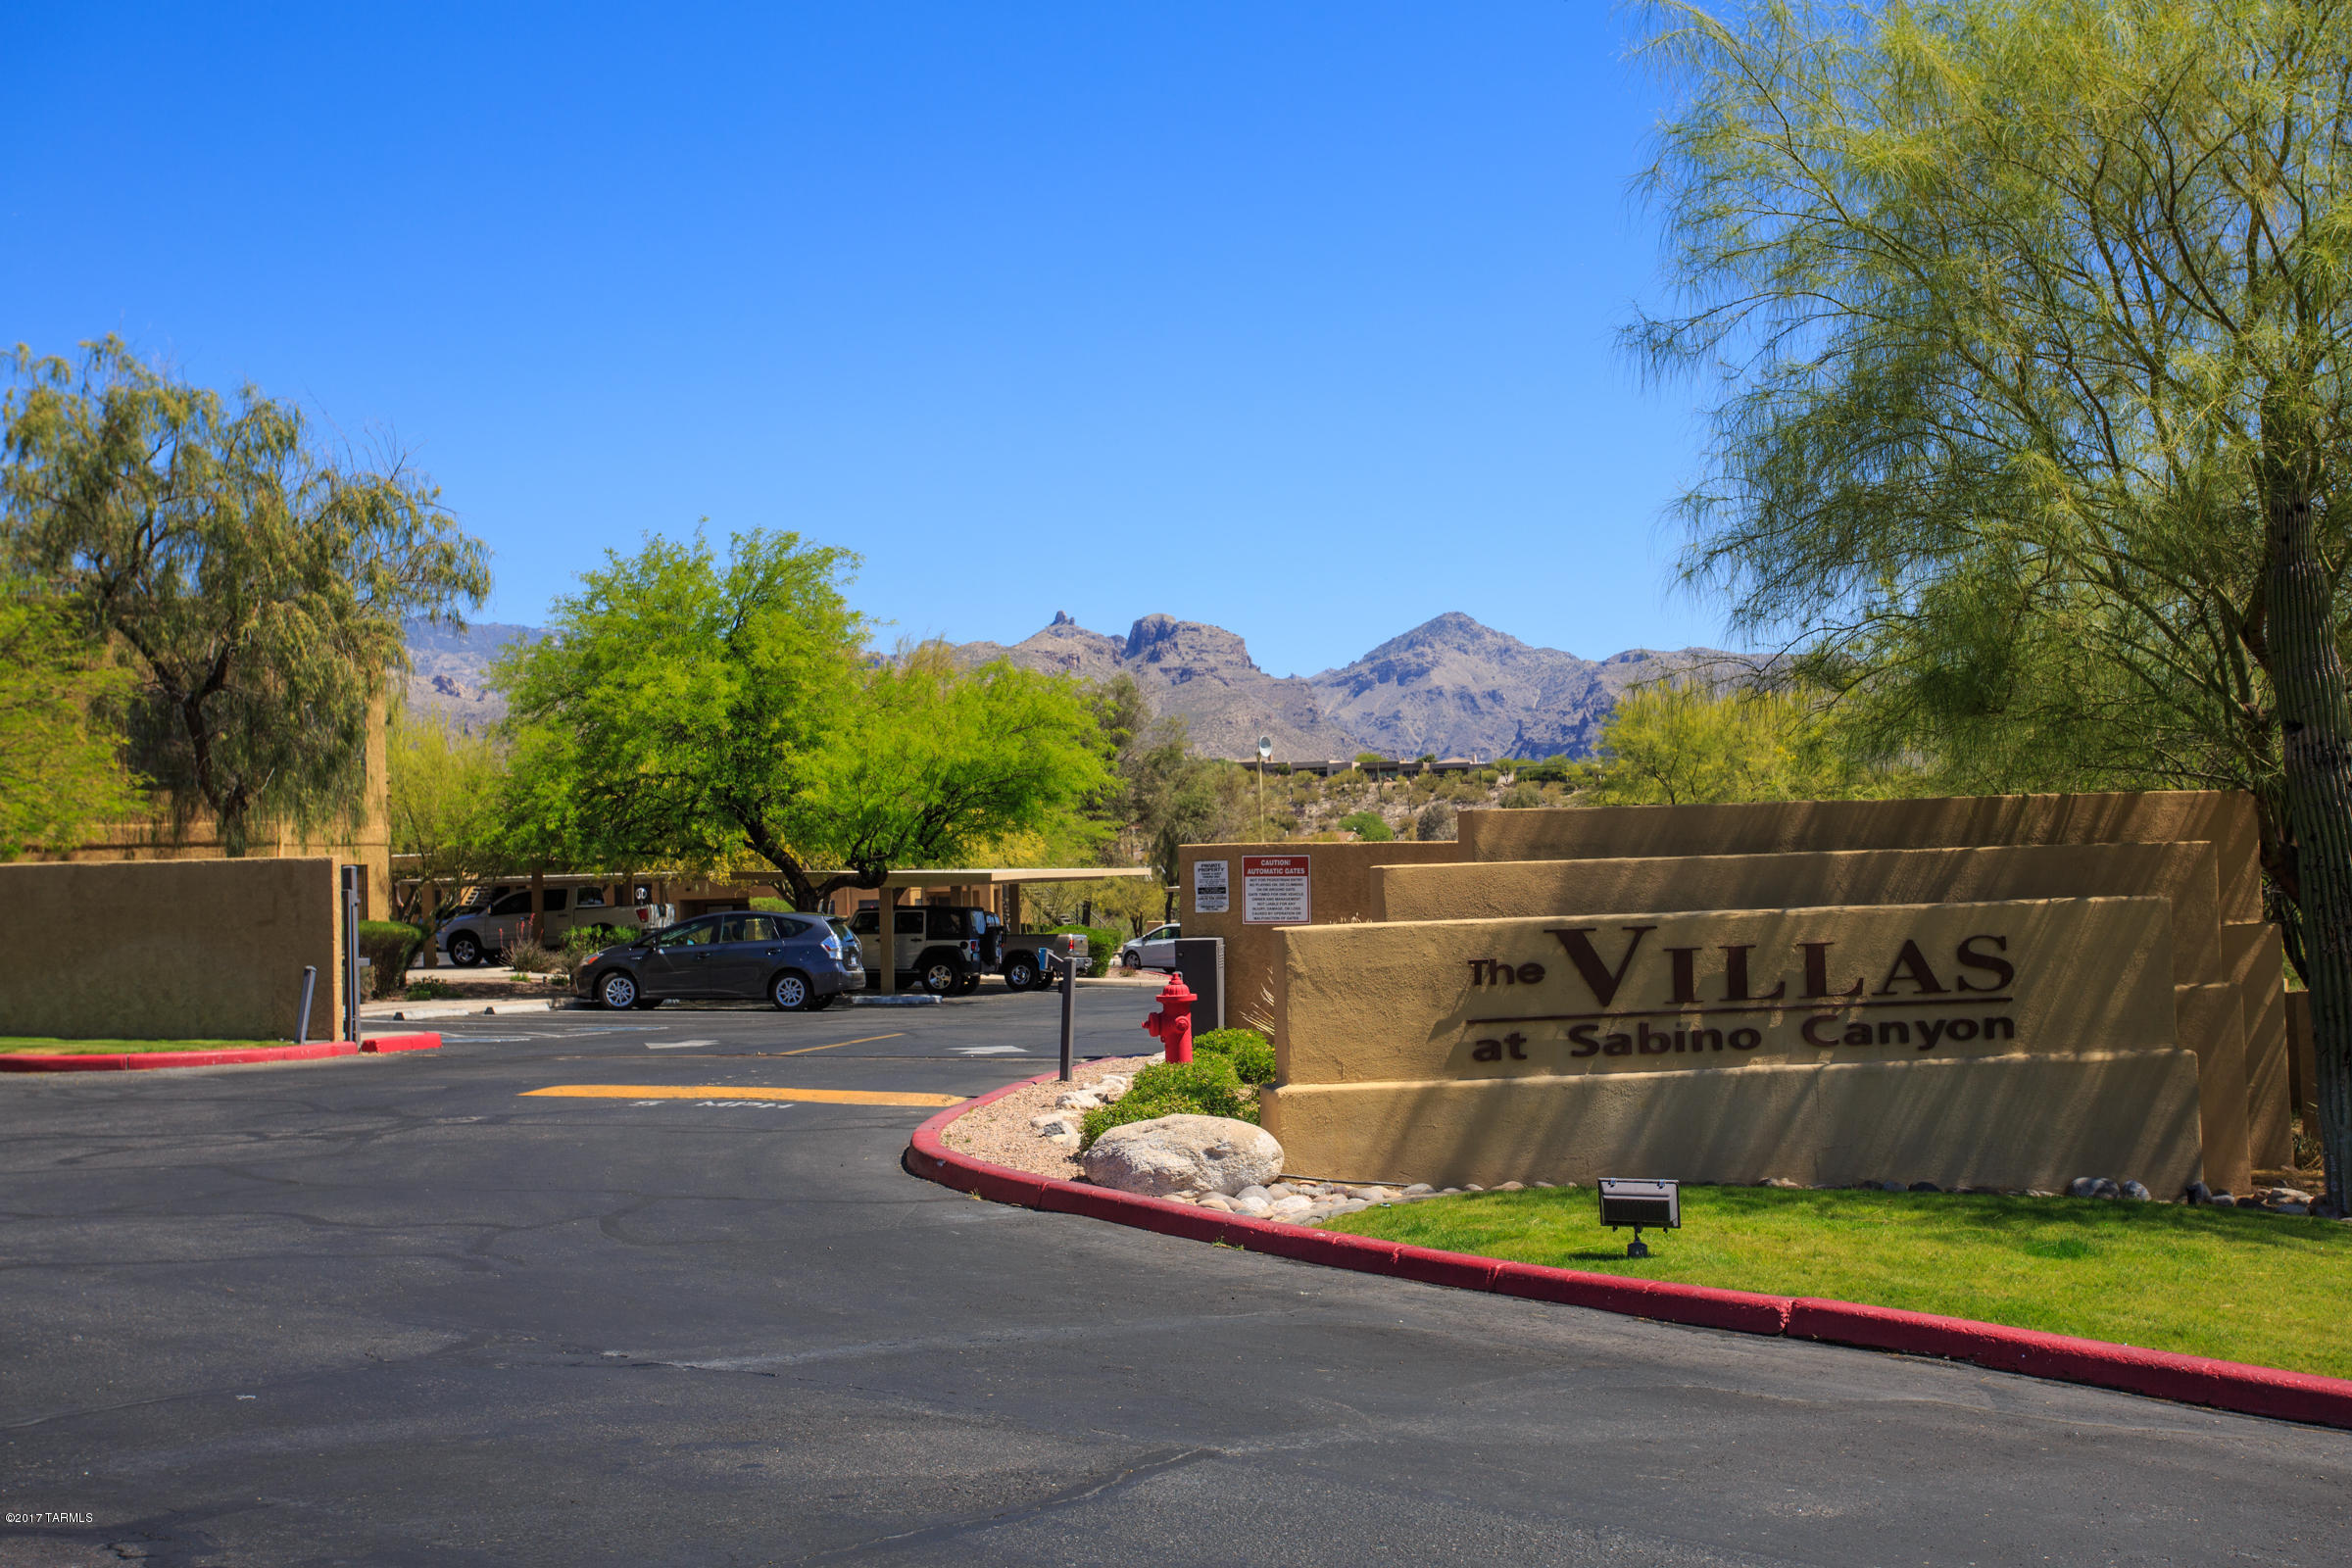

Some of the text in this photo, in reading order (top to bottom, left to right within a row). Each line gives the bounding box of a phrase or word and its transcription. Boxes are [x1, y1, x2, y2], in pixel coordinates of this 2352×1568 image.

[1468, 925, 2015, 1007] The VILLAS
[1472, 1015, 2015, 1061] at Sabino Canyon
